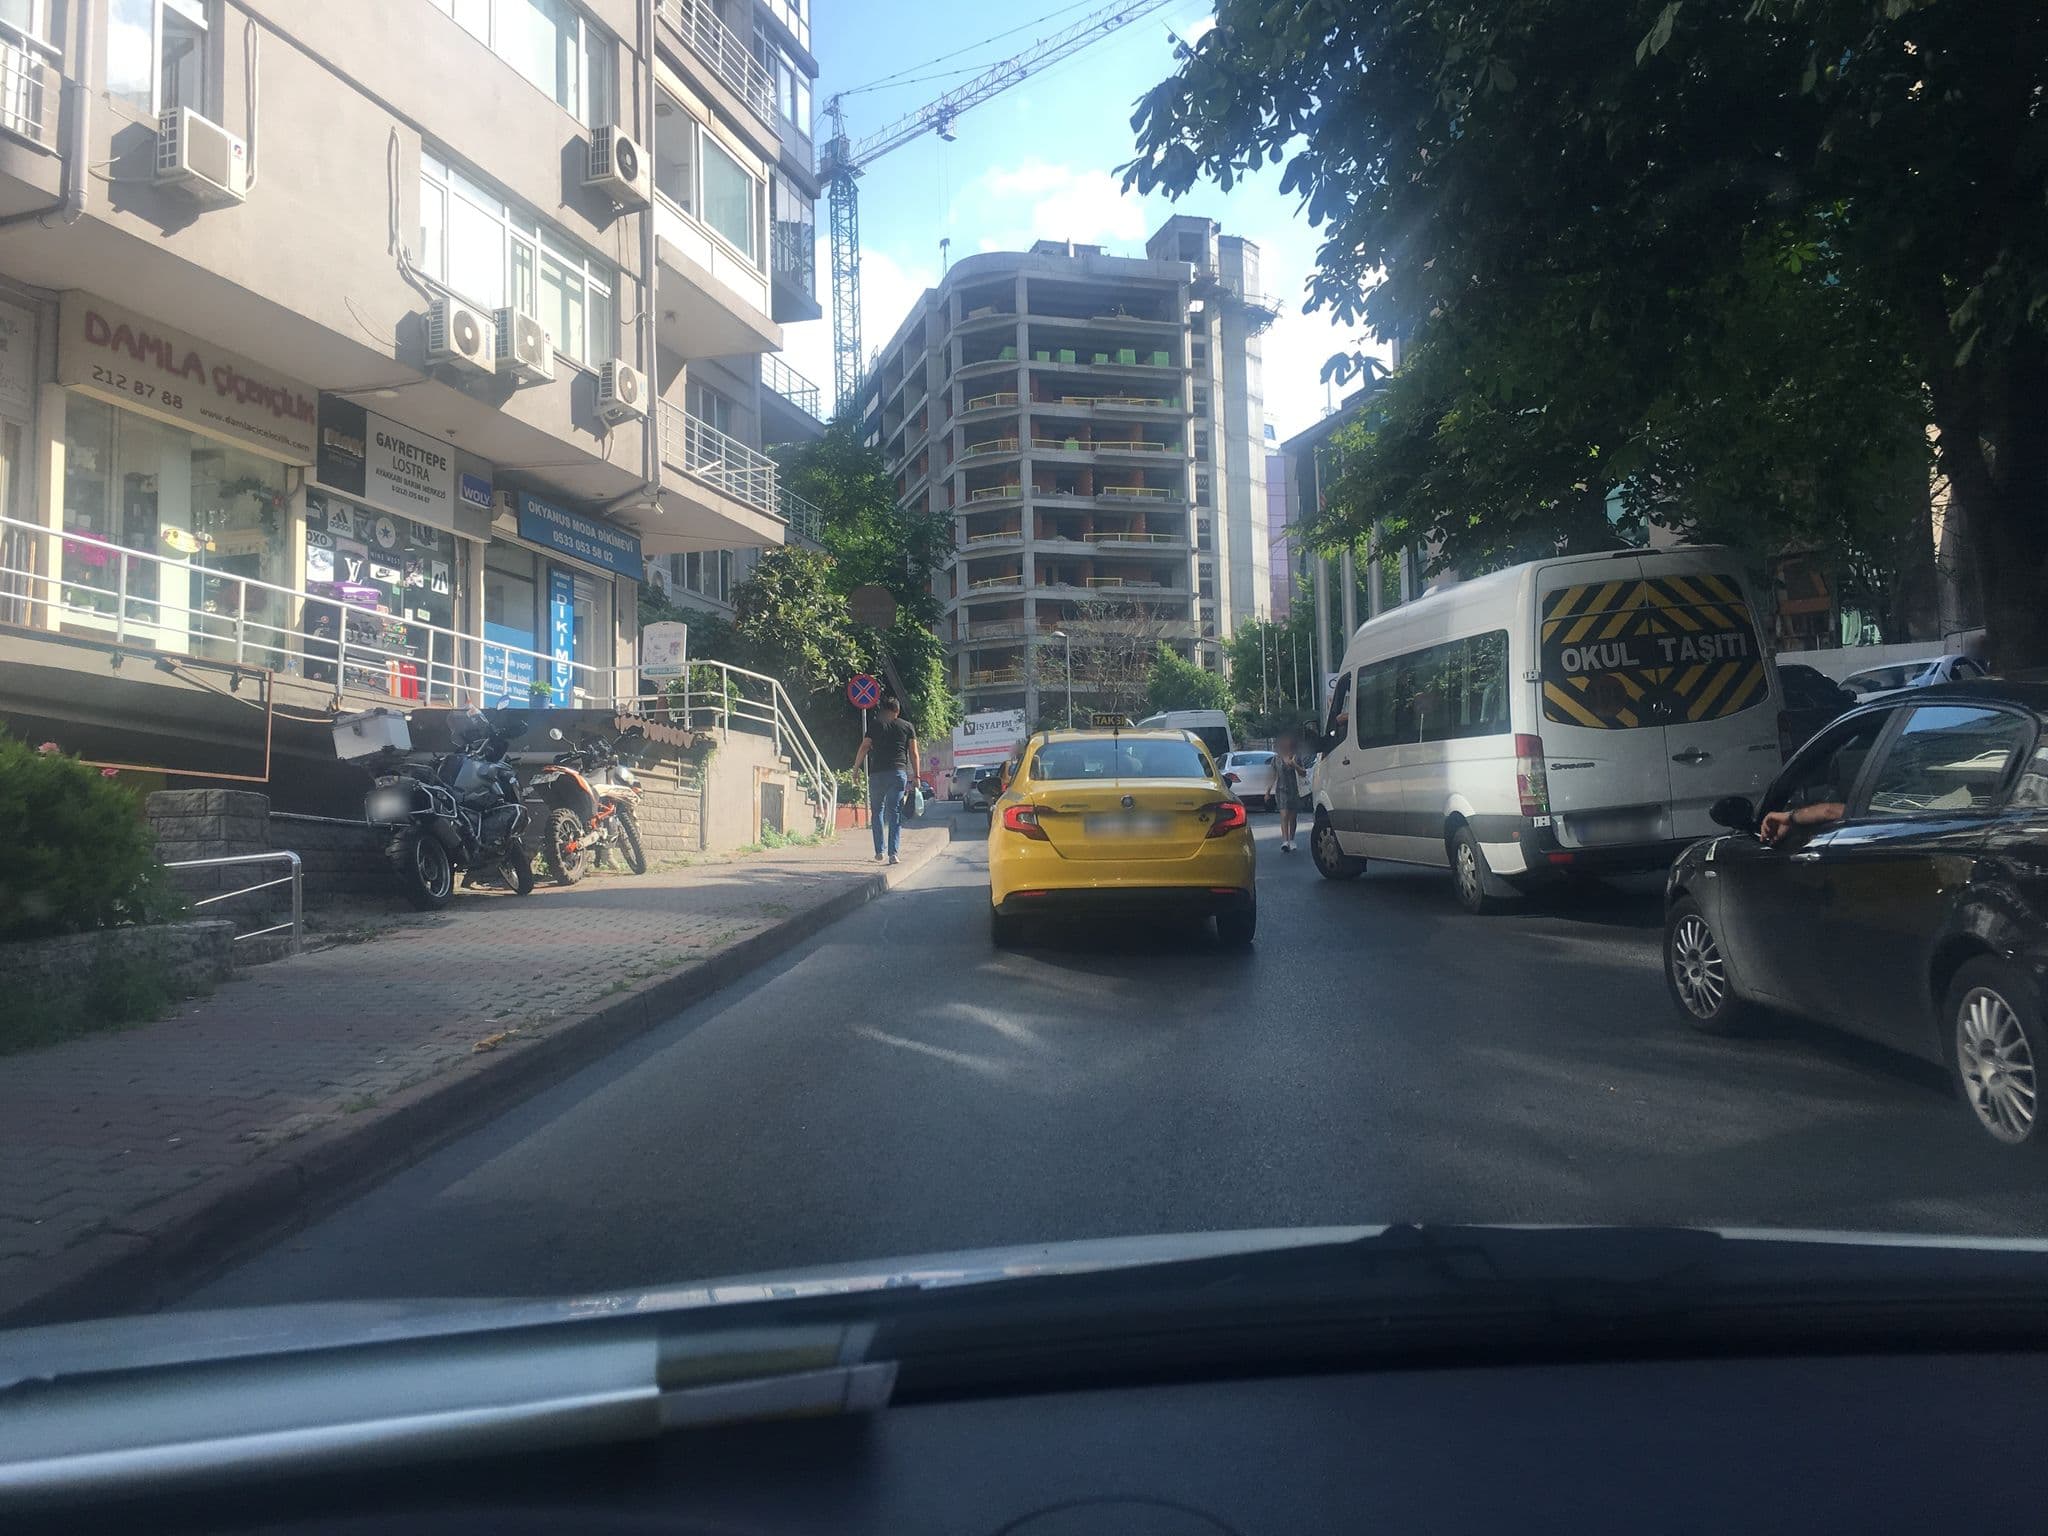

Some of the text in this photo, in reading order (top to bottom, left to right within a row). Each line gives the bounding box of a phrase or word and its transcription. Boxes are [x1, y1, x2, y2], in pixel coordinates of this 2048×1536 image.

[85, 310, 206, 385] DAMLA
[91, 365, 184, 410] 212 87 88
[376, 431, 447, 471] GAYRETTEPE
[392, 455, 431, 483] LOSTRA
[464, 485, 490, 505] WOLY
[527, 500, 571, 529] OKYANUS
[572, 519, 597, 539] MODA
[552, 530, 574, 548] 0533
[1561, 632, 1748, 672] OKUL TAŞITI
